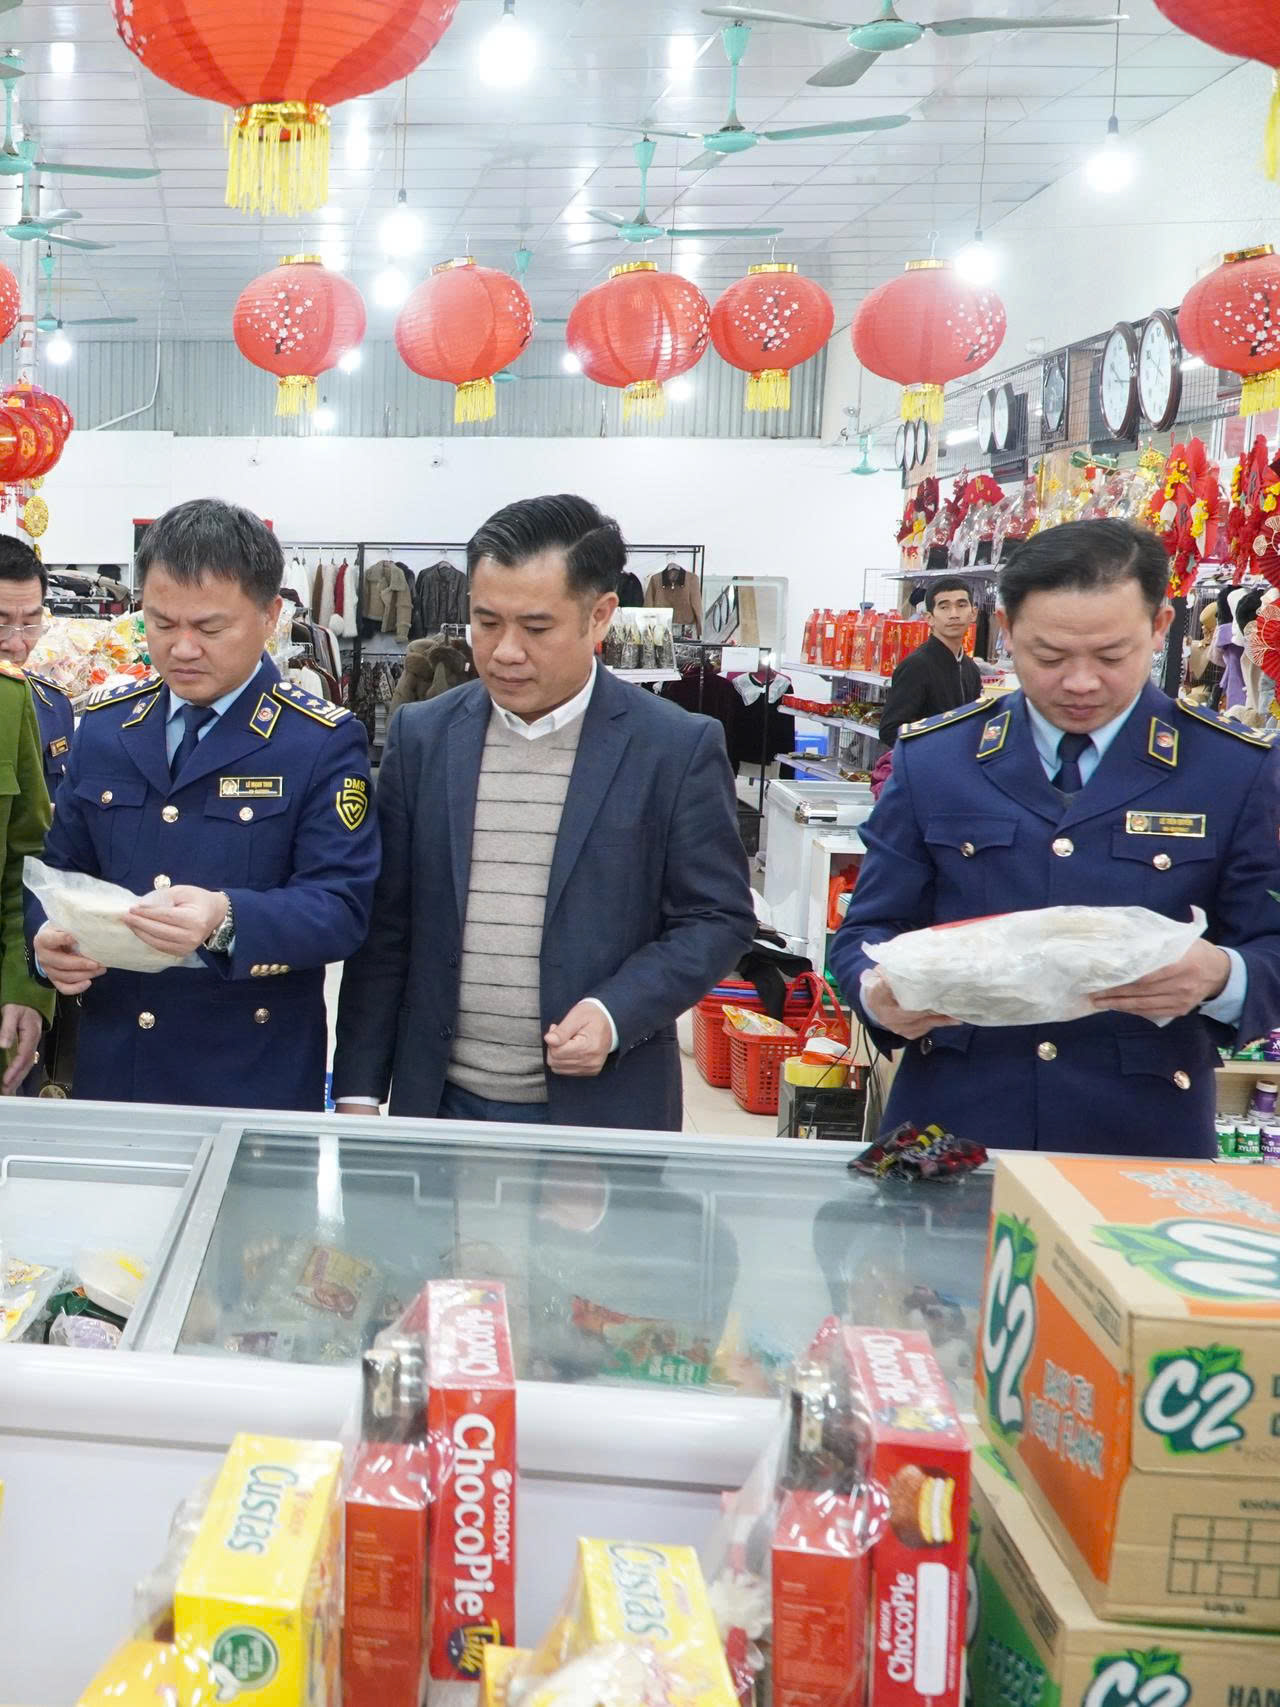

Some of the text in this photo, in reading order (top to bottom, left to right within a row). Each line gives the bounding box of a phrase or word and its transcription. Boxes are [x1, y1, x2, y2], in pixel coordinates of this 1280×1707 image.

[344, 778, 366, 792] DMS
[983, 1237, 1035, 1426] C2
[1144, 1359, 1253, 1449] C2
[228, 1464, 299, 1554] Custas
[453, 1413, 496, 1618] ChocoPie
[493, 1493, 511, 1562] ORION
[609, 1543, 669, 1640] Custas
[887, 1571, 915, 1683] ChocoPie
